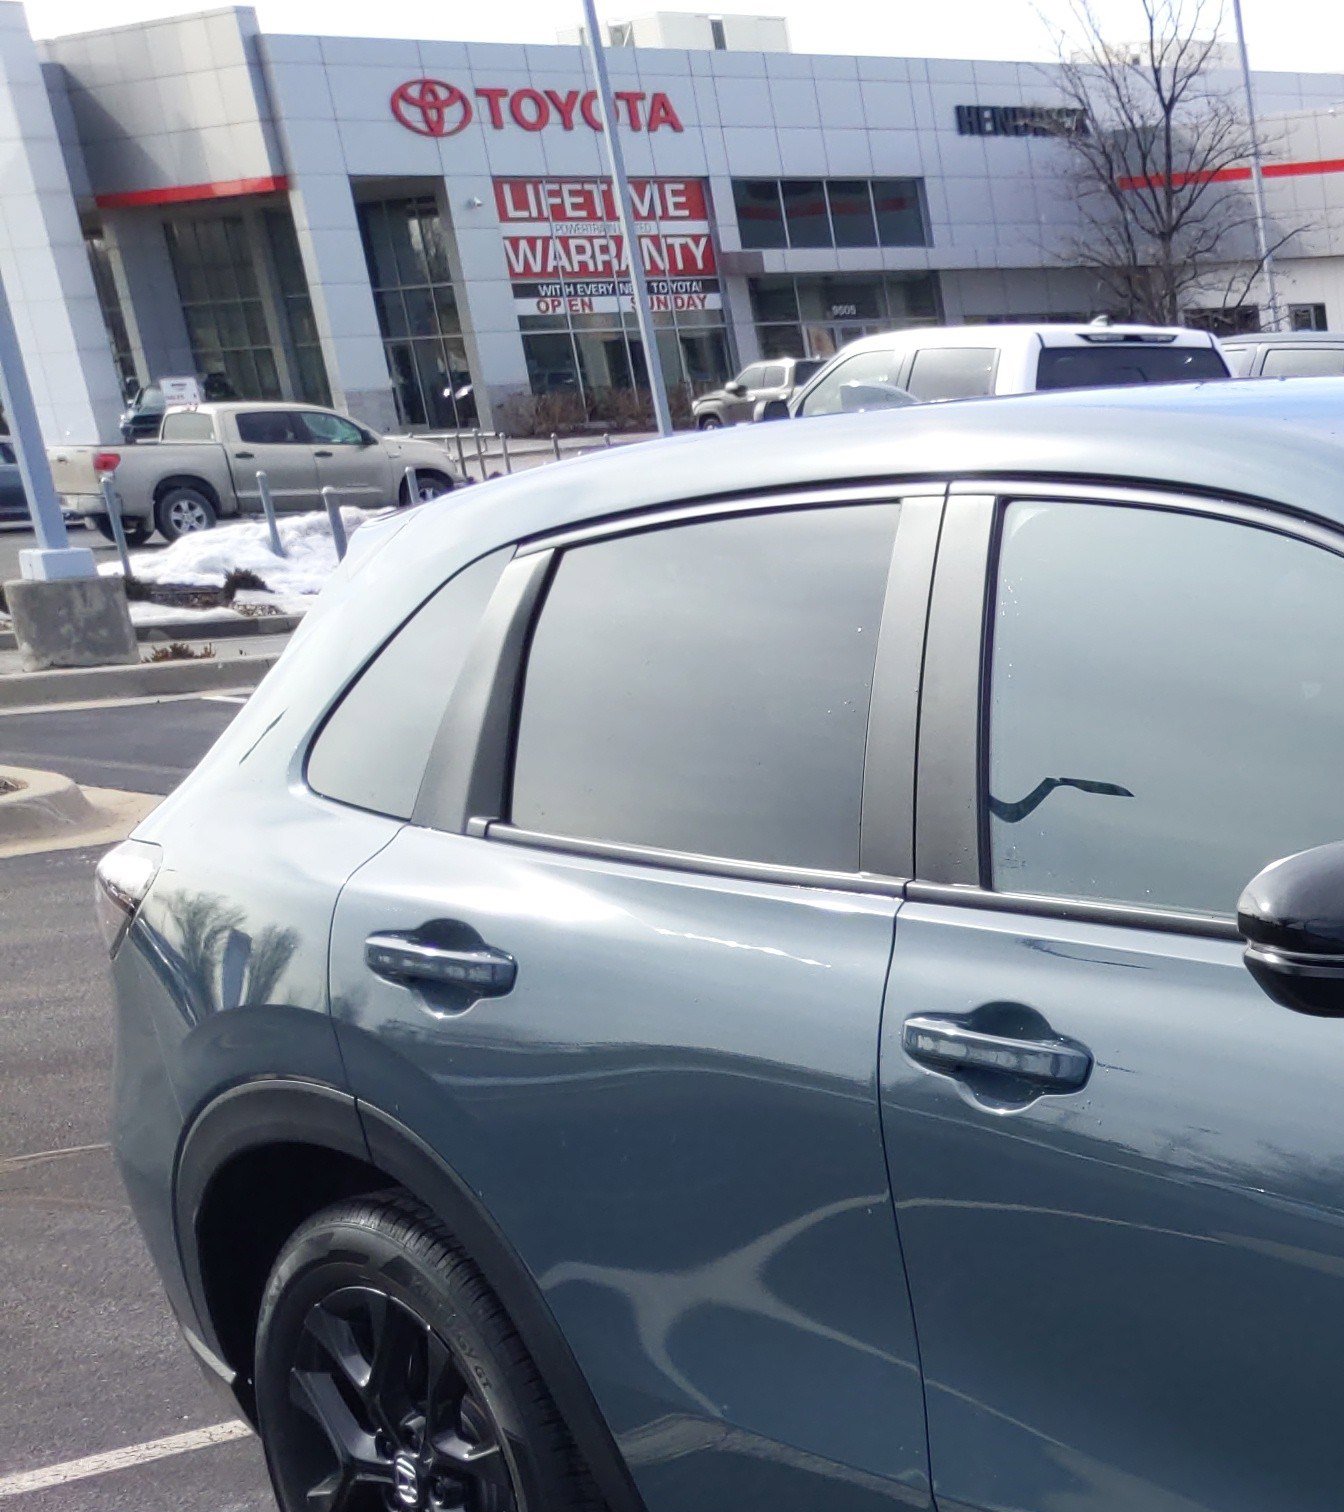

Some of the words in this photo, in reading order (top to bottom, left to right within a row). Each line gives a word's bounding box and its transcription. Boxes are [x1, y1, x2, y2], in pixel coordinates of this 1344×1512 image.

[475, 88, 683, 132] TOYOTA
[955, 104, 1092, 137] HENDRK
[502, 183, 690, 219] LIFETIME
[538, 283, 575, 296] WITH
[577, 281, 613, 296] EVERY
[620, 281, 636, 295] NE
[536, 298, 594, 313] OPEN
